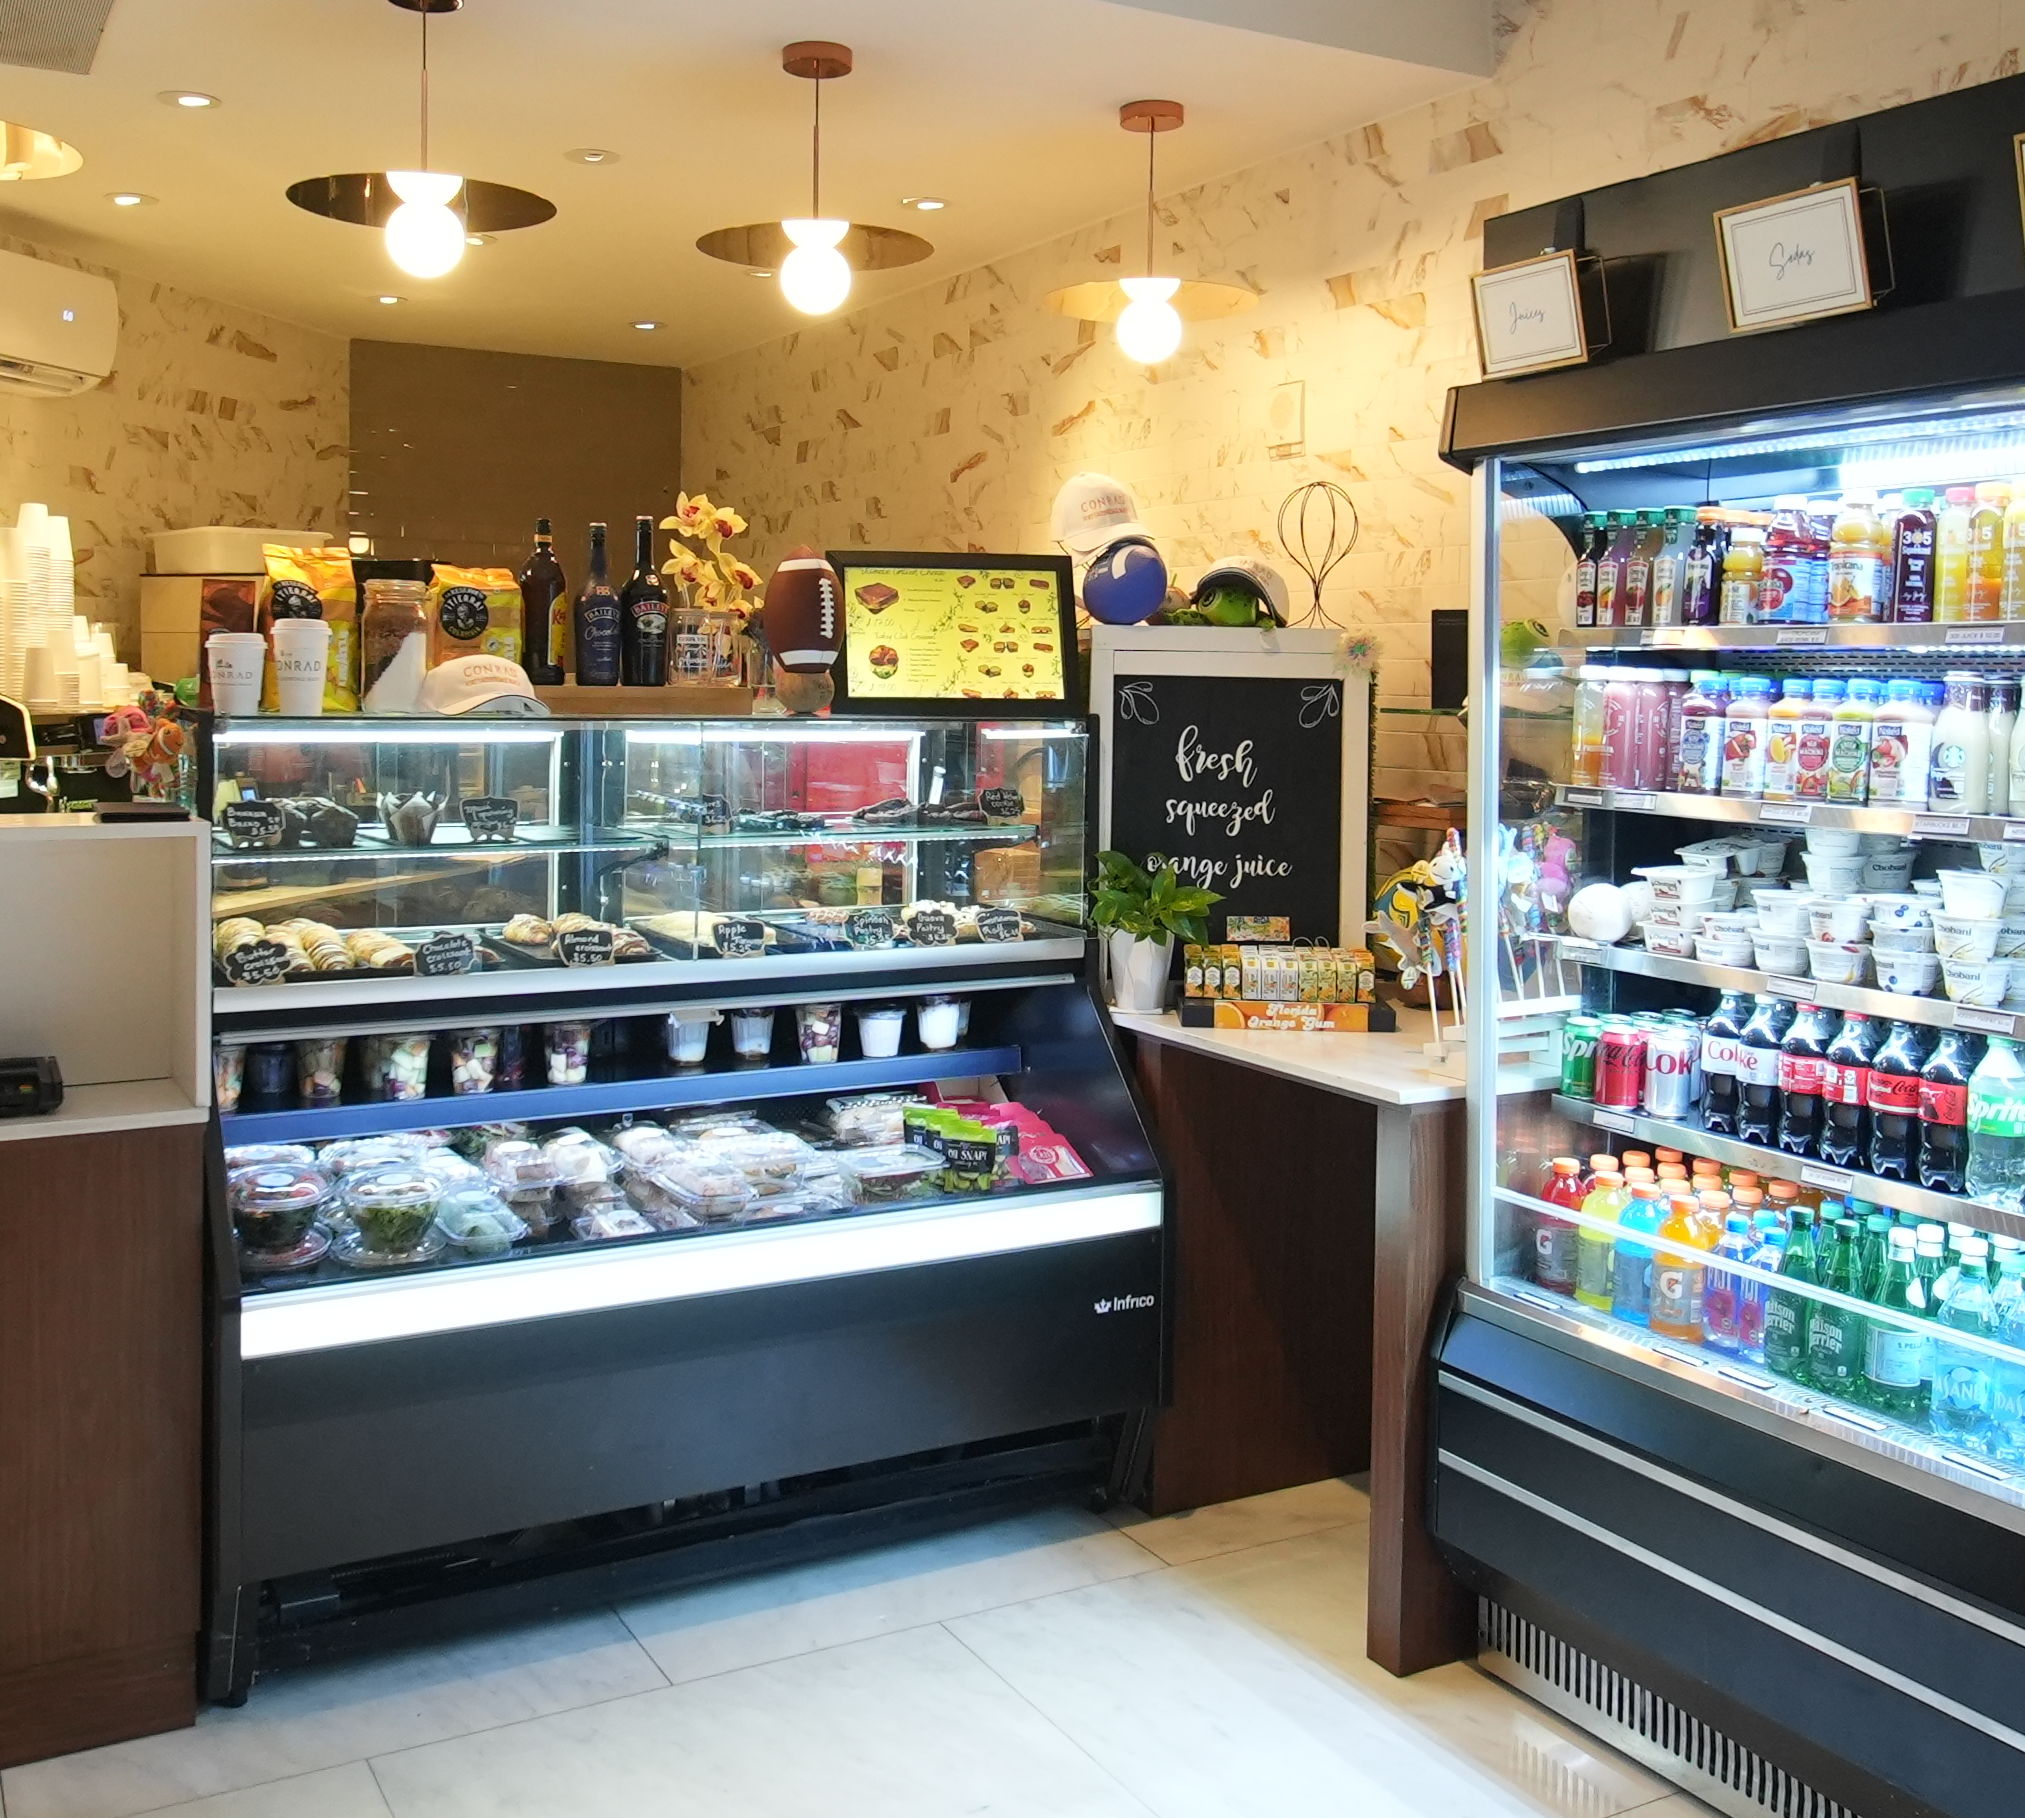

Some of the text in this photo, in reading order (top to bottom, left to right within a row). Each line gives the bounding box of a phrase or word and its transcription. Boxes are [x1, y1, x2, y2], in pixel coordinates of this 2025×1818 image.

[1175, 724, 1258, 788] fresh
[1165, 788, 1276, 837] squeezed
[1146, 853, 1293, 890] oange juice
[1562, 1032, 1597, 1062] Spr
[1645, 1042, 1692, 1076] Cok
[1660, 1271, 1684, 1299] G
[1113, 1294, 1155, 1312] Infrico
